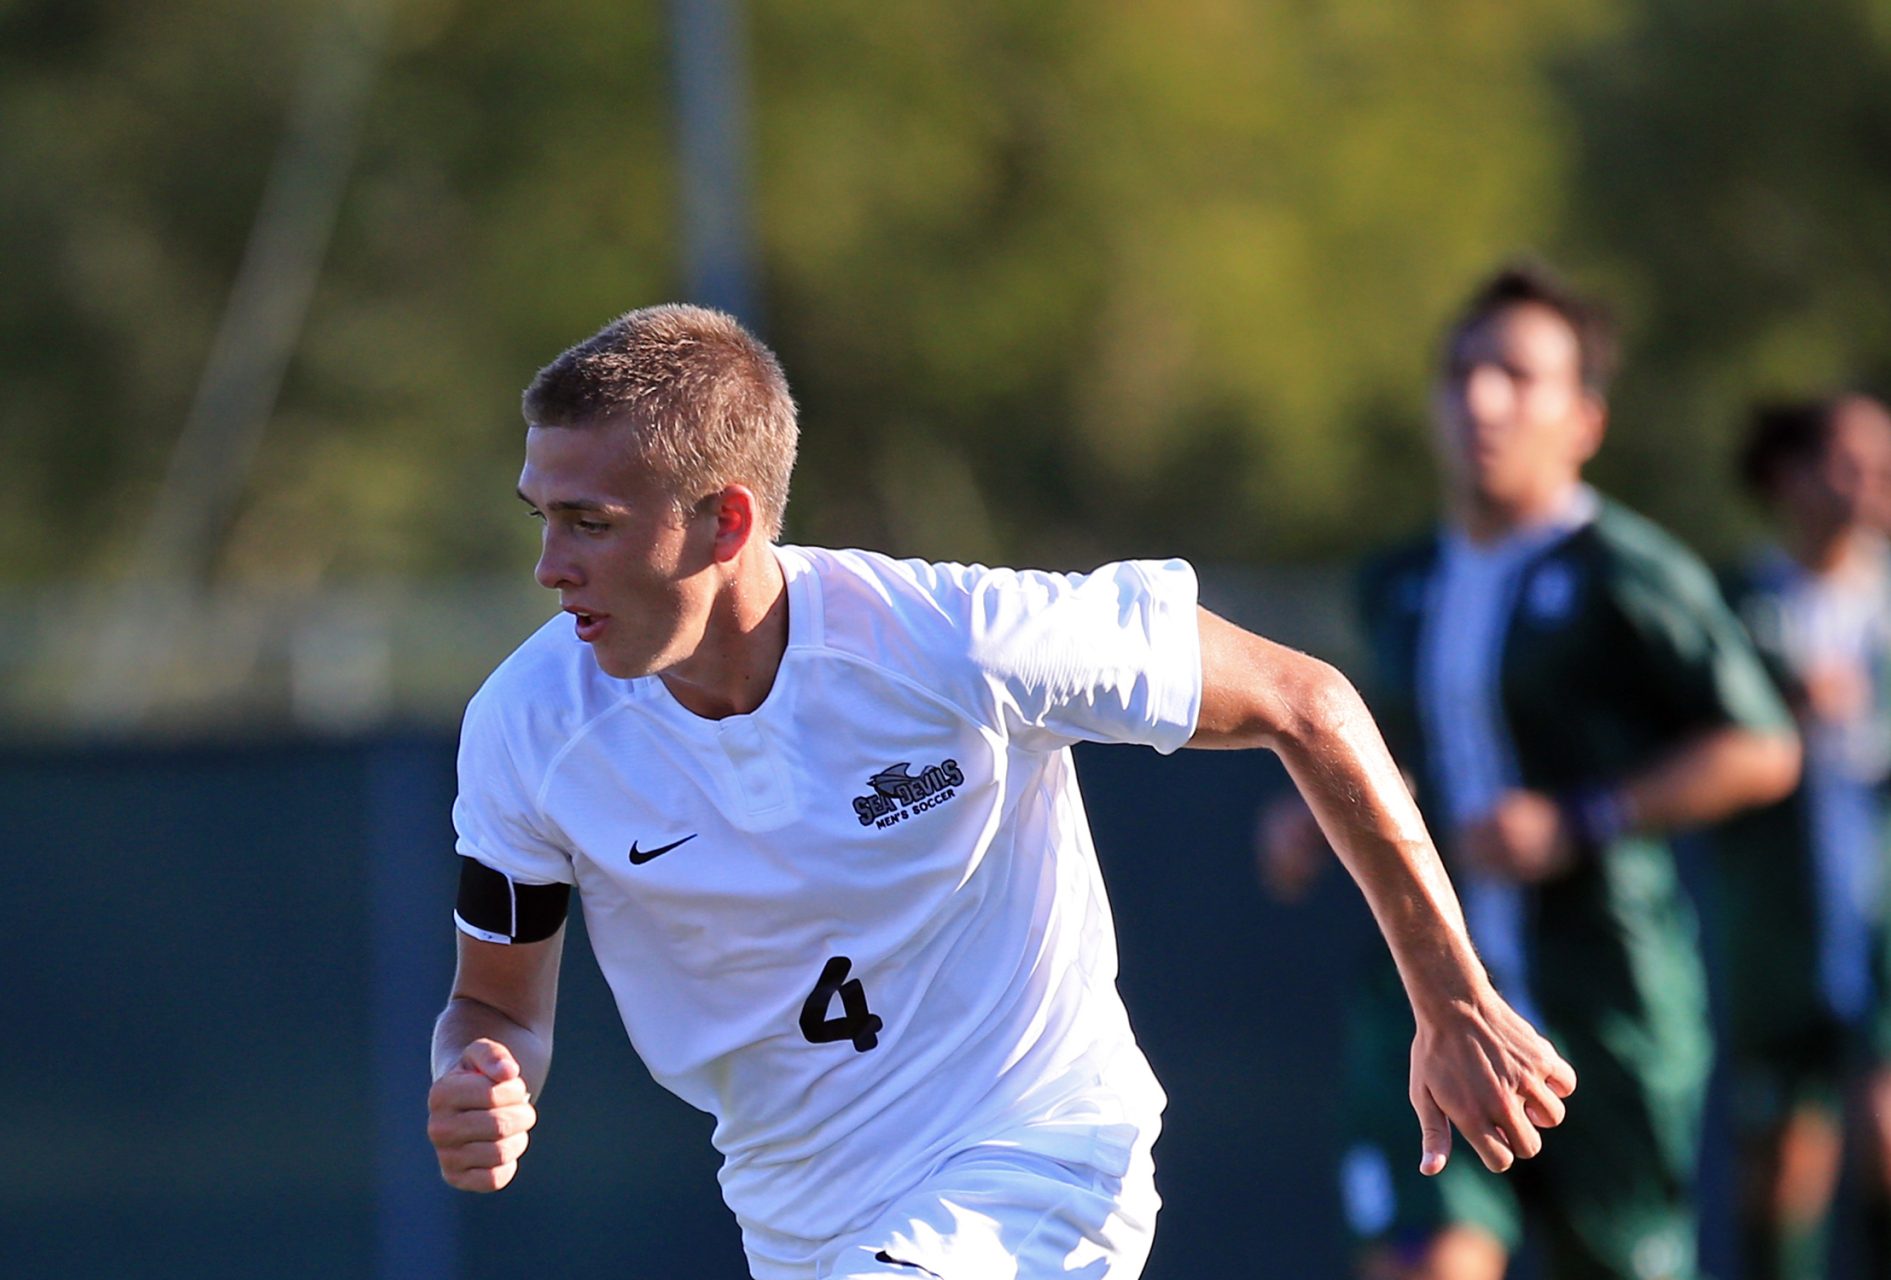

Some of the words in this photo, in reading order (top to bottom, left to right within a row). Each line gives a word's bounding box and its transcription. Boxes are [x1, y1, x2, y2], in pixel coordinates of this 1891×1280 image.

[852, 794, 897, 826] SEA
[895, 759, 964, 807] DEVILS
[876, 810, 909, 830] MEN'S
[912, 789, 956, 815] SOCCER
[799, 956, 883, 1053] 4
